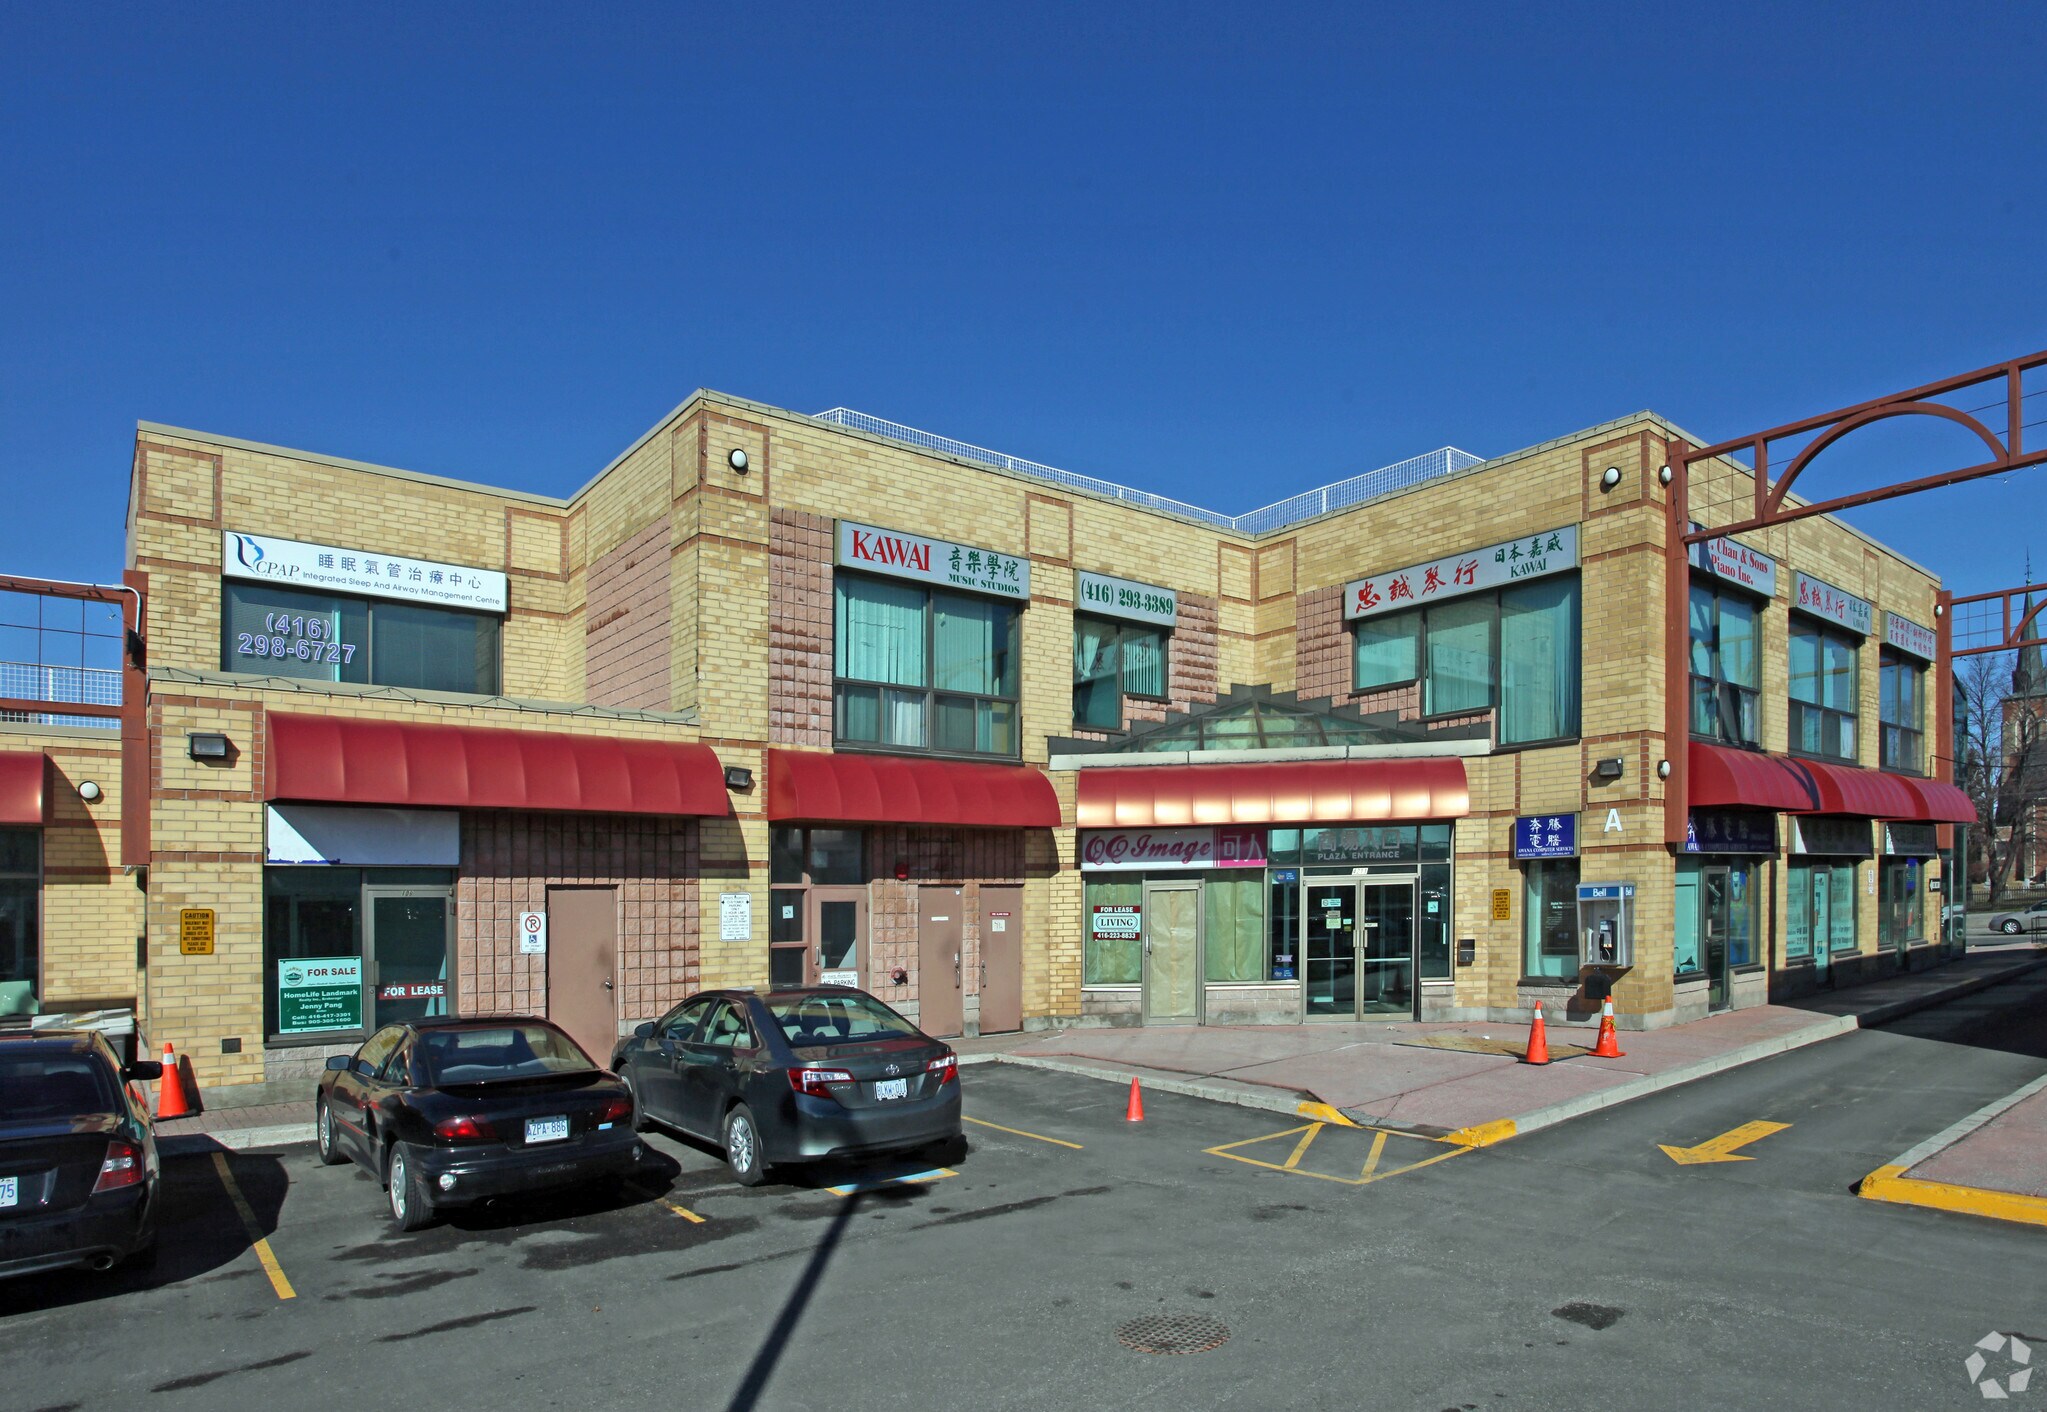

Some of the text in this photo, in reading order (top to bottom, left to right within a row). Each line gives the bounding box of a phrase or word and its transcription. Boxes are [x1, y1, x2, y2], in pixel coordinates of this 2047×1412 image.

[851, 529, 931, 573] KAWAI
[948, 546, 1020, 582] 音樂學院
[1741, 548, 1747, 565] &
[1749, 552, 1768, 574] Sons
[256, 560, 300, 577] CPAP
[318, 553, 482, 590] 睡眠氣管治療中心
[1510, 558, 1547, 579] KAWAI
[1711, 553, 1754, 585] Piano Inc.
[303, 571, 500, 605] Integrated Sleep And Airway Management Centre
[948, 573, 1020, 595] MUSIC STUDIOS
[1081, 578, 1114, 607] (416)
[1355, 558, 1480, 614] 忠誠琴行
[265, 612, 332, 640] (416)
[237, 632, 356, 664] 298-6727
[1603, 808, 1623, 833] A
[1130, 834, 1211, 864] Image
[1222, 833, 1263, 862] 可人
[1317, 850, 1400, 860] PLAZA ENTRANCE
[1592, 888, 1607, 897] Bell
[1100, 918, 1133, 926] LIVING
[307, 968, 328, 977] FOR
[331, 967, 357, 976] SALE
[284, 989, 358, 999] HomeLife Landmark
[384, 985, 444, 997] FOR LEASE
